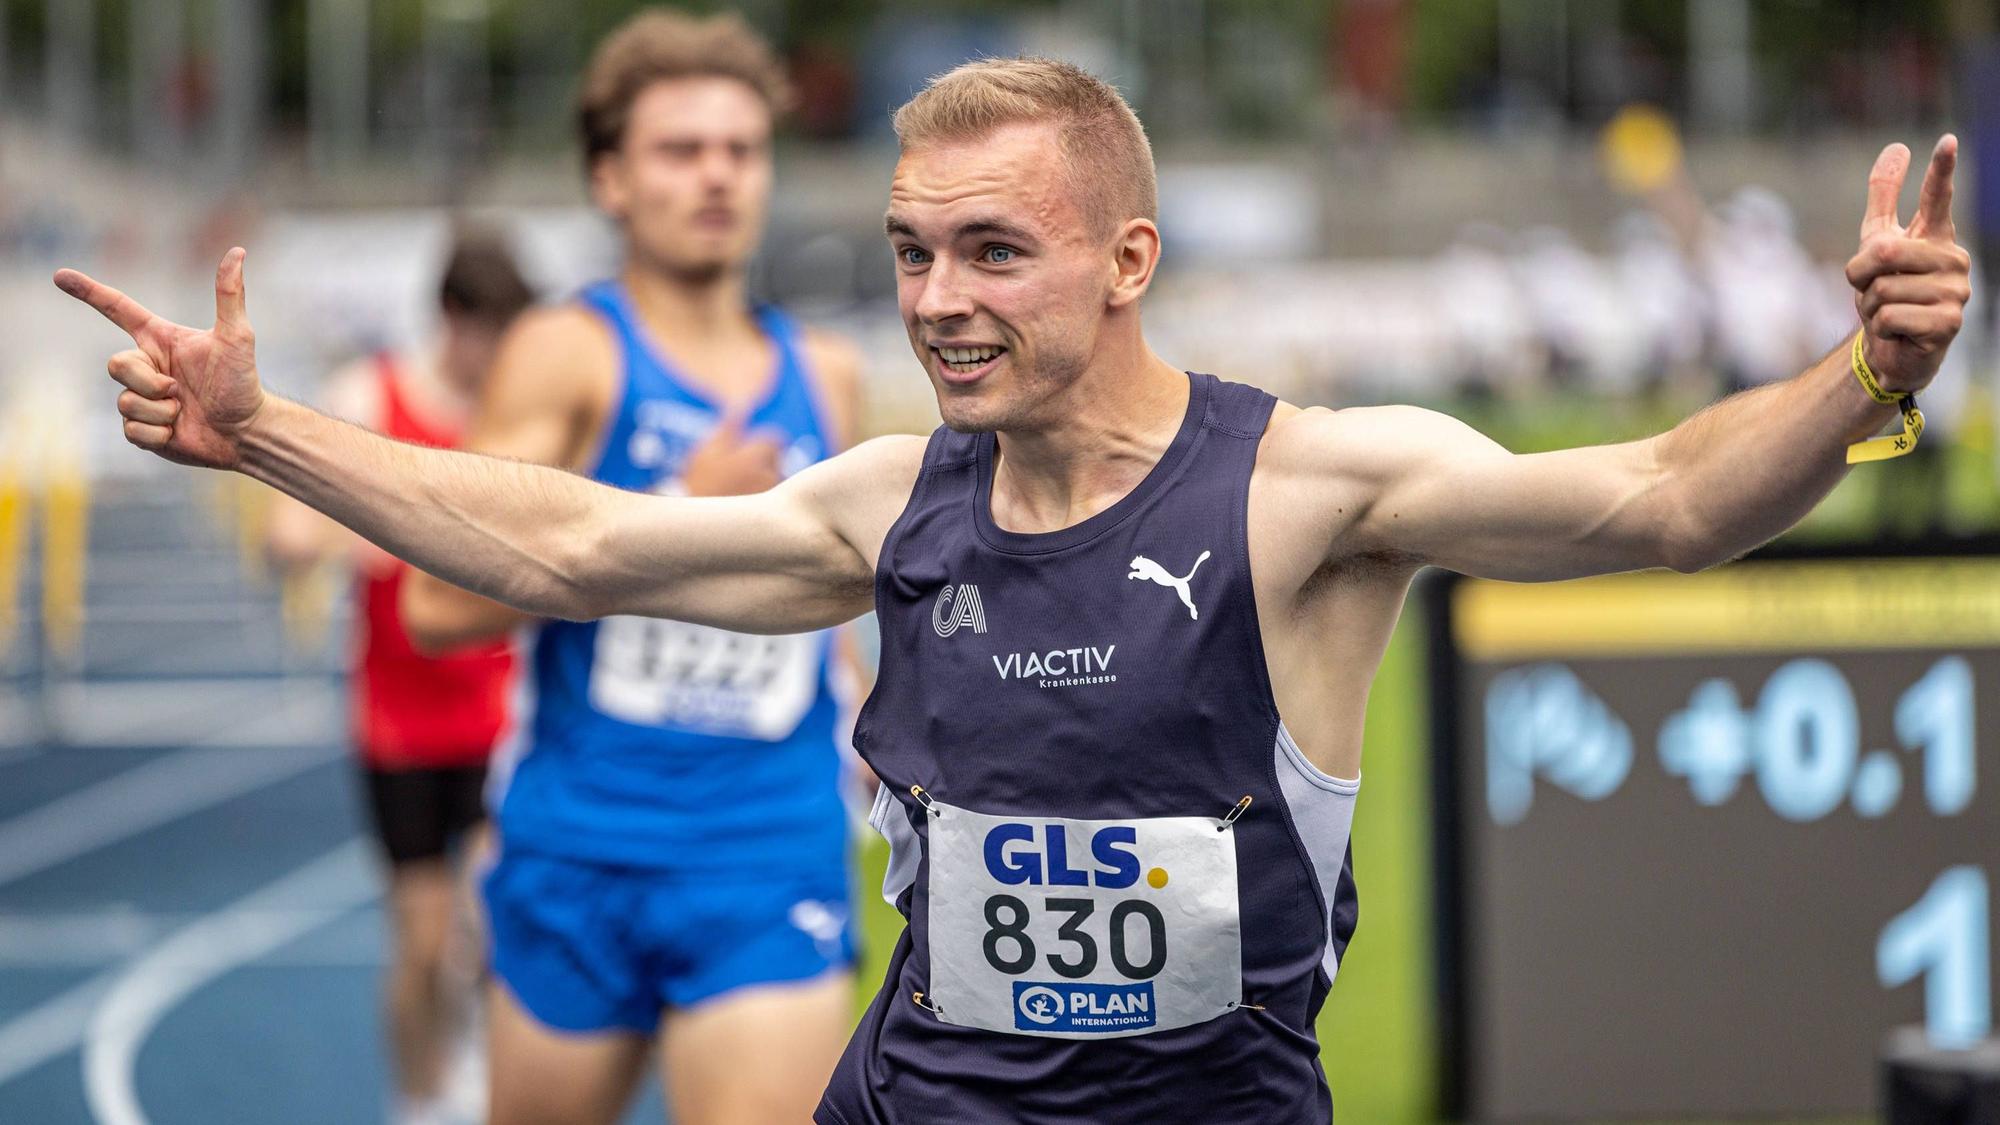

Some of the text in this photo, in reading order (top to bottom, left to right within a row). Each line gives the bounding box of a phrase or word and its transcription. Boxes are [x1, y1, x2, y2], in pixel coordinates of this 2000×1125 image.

[992, 645, 1116, 680] VIACTIV
[1039, 674, 1117, 689] Krankenkasse
[1656, 655, 1977, 822] +0.1
[982, 893, 1168, 980] 830
[1070, 991, 1149, 1015] PLAN
[1071, 1015, 1150, 1027] INTERNATIONAL
